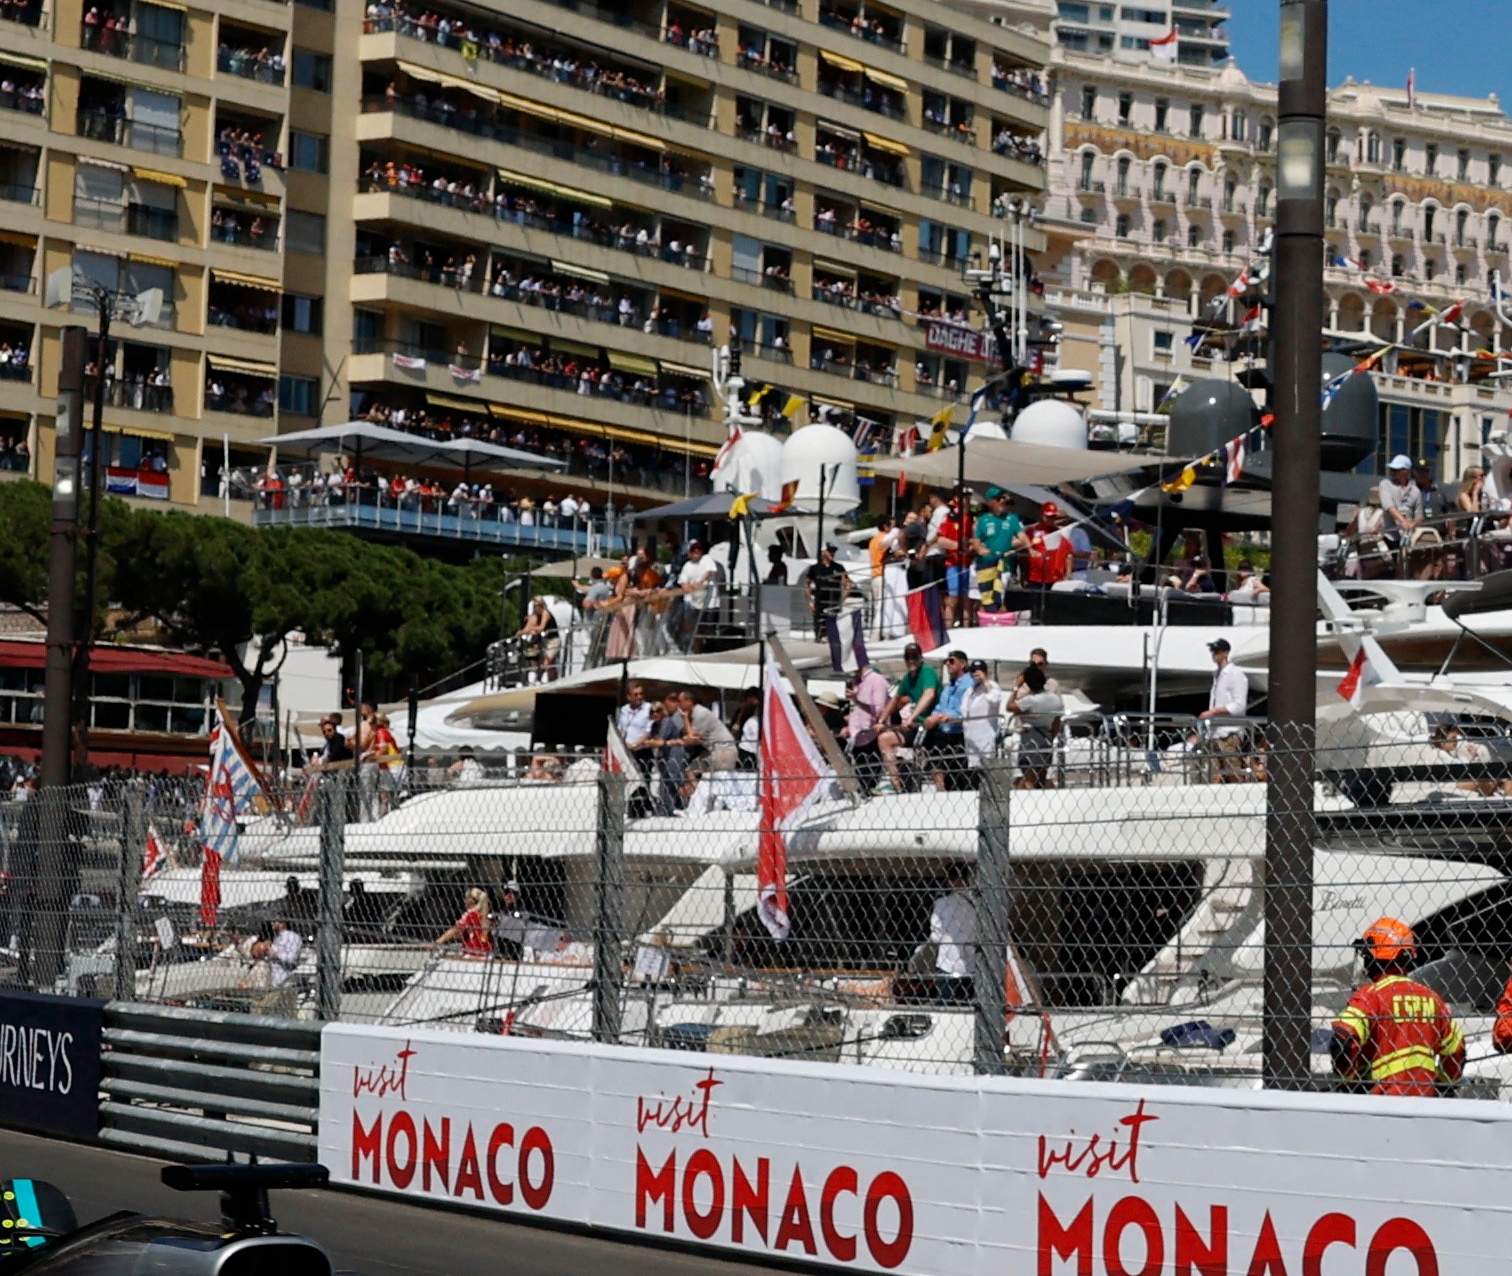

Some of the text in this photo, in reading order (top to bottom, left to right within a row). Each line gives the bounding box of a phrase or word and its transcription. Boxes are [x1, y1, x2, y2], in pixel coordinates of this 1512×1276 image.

[353, 1039, 417, 1101] visit
[637, 1066, 724, 1139] visit
[352, 1106, 555, 1211] MONACO
[1038, 1098, 1160, 1184] visit
[635, 1142, 914, 1269] MONACO
